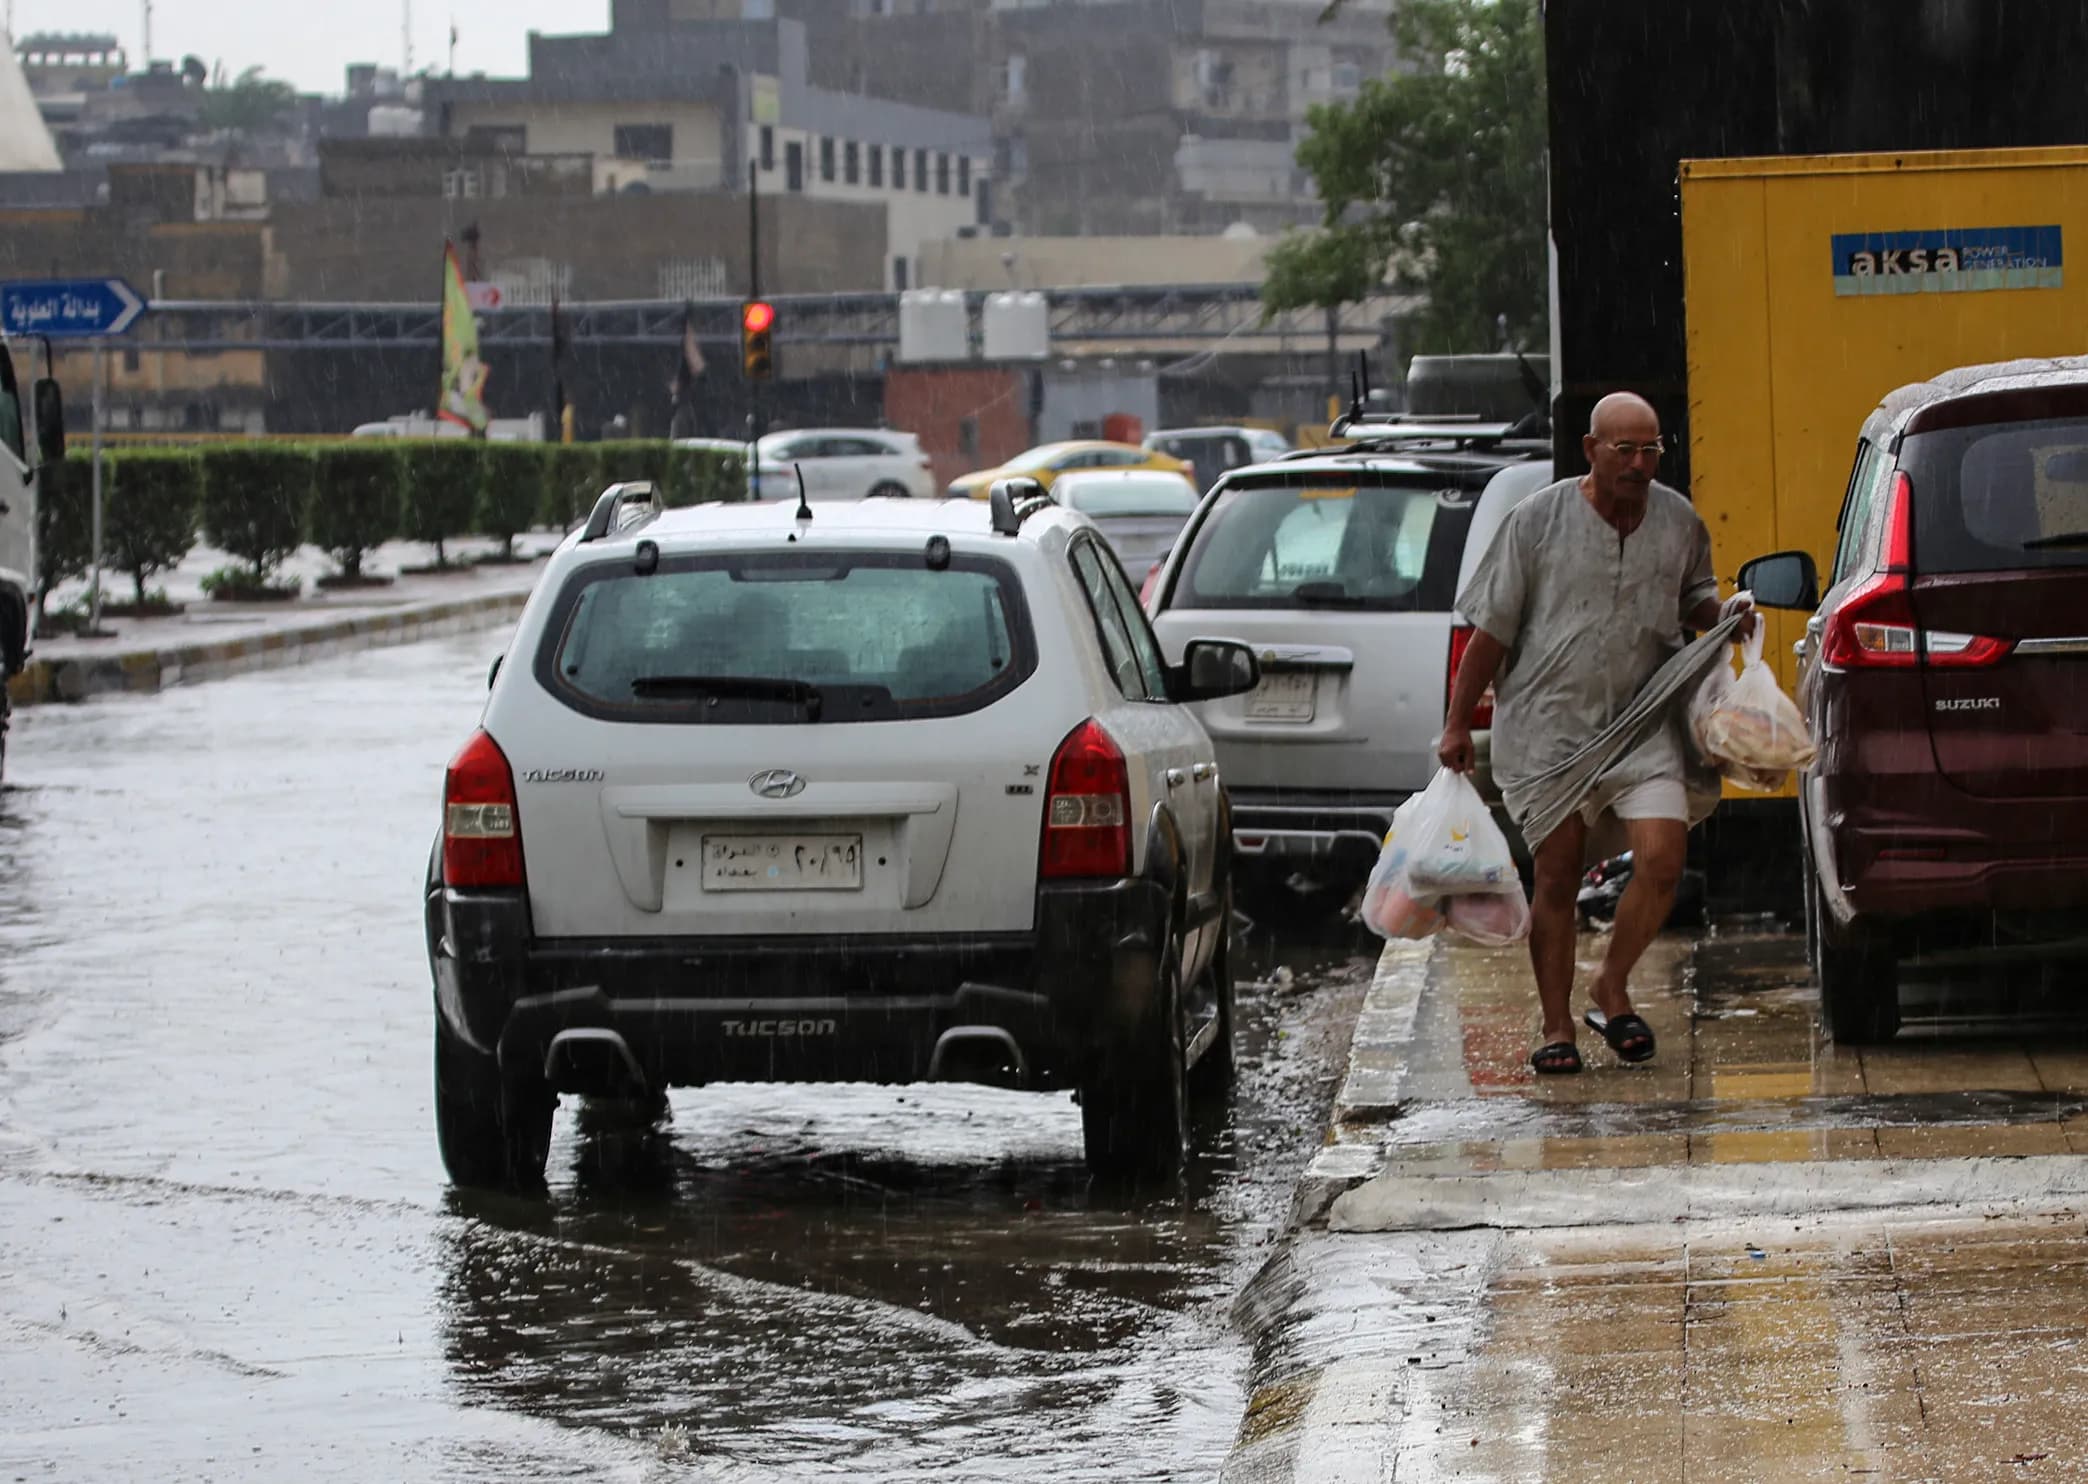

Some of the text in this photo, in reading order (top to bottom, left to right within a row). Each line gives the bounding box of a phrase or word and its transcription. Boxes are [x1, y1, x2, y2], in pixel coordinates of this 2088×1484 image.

[1852, 247, 1959, 278] aksa
[1935, 697, 2000, 711] SUZUKI
[721, 1020, 836, 1037] TUCSON
